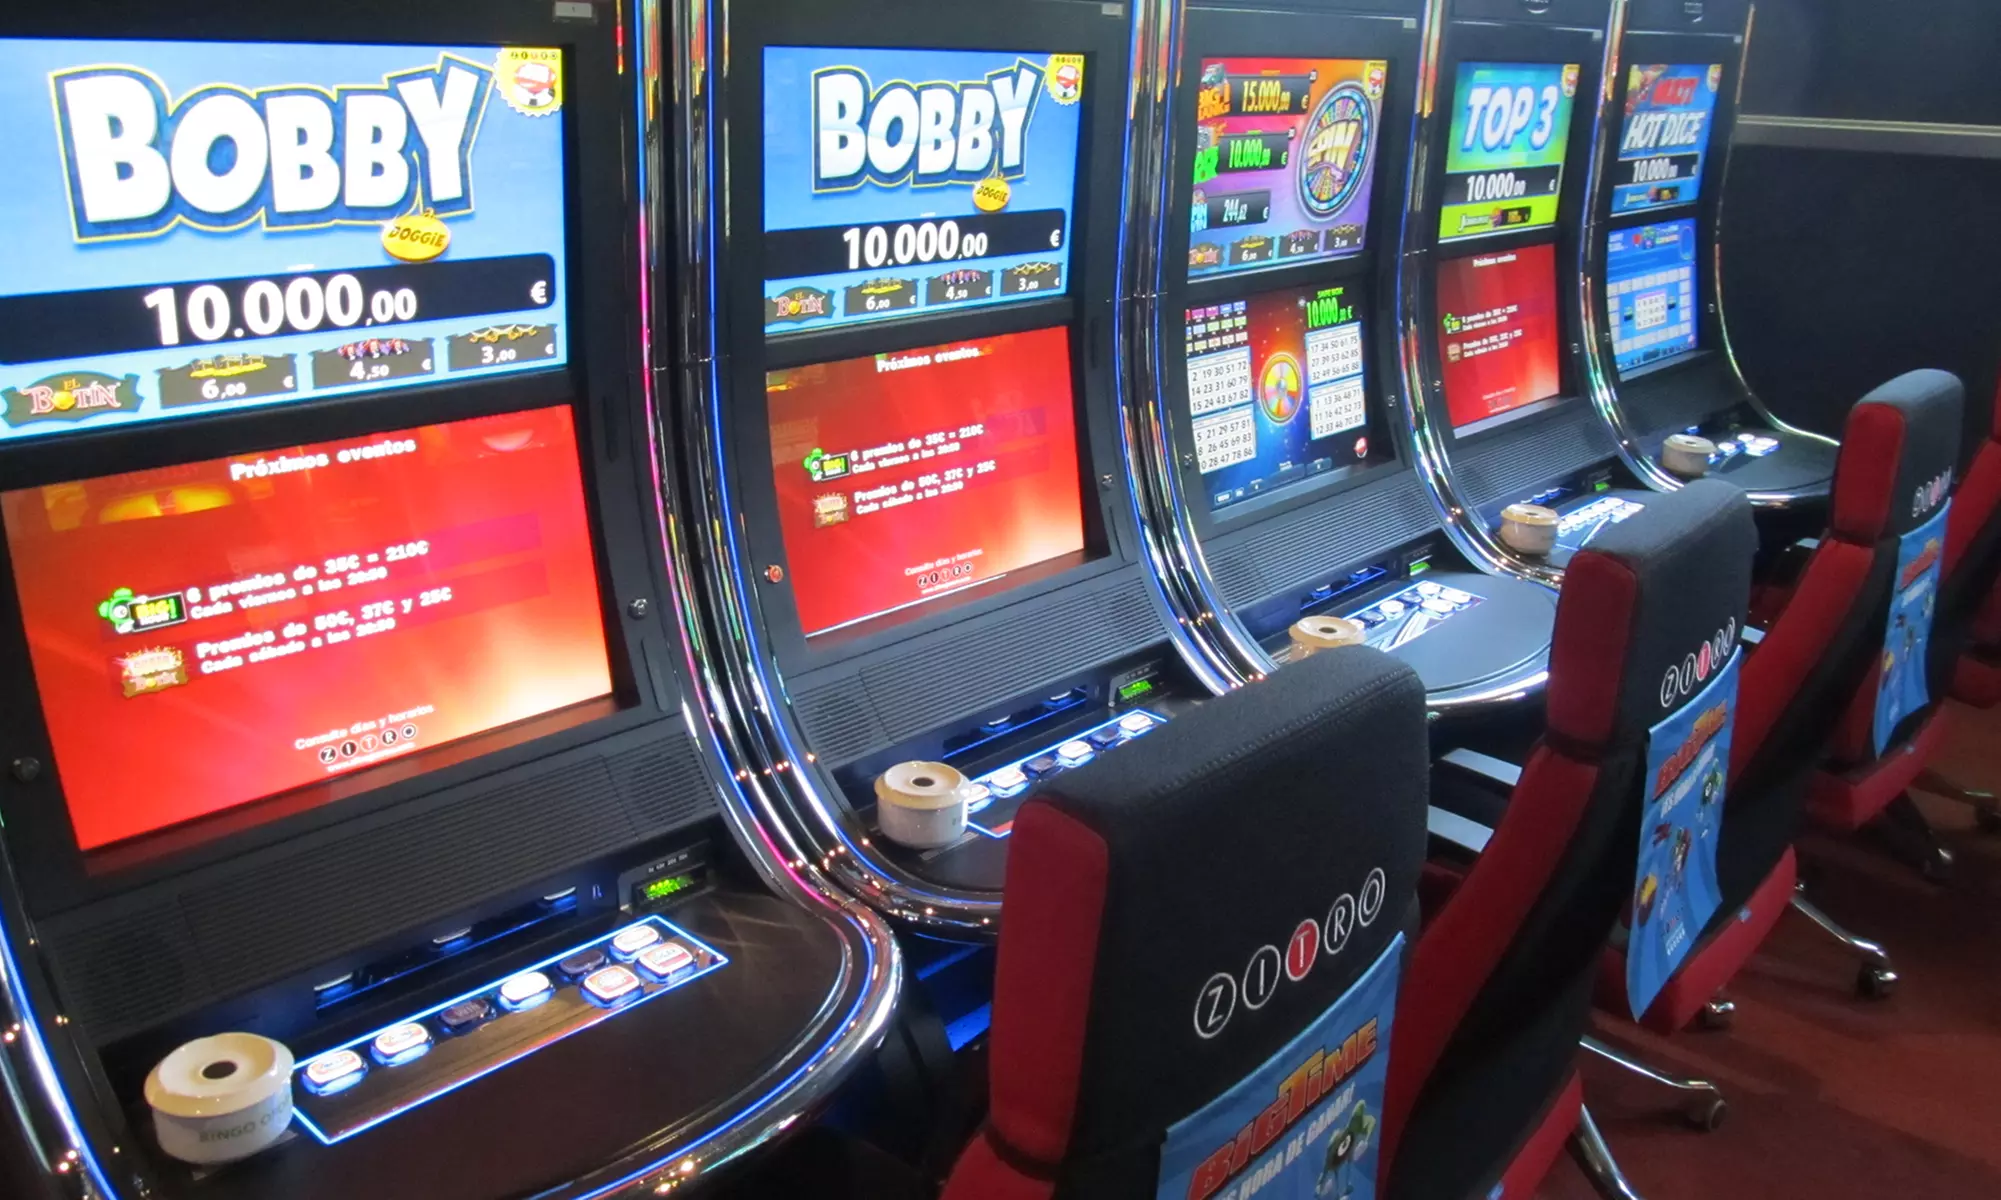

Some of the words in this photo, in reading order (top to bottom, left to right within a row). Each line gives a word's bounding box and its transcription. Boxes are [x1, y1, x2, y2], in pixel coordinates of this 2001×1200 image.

[818, 67, 1037, 179] BOBBY
[1463, 86, 1534, 150] TOP
[1529, 86, 1559, 150] 3
[1621, 113, 1667, 152] HOT
[1659, 111, 1706, 147] DICE
[62, 64, 482, 225] BOBBY
[843, 220, 988, 269] 10.000,00
[1050, 229, 1061, 247] €
[143, 273, 418, 346] 10.000,00
[530, 281, 549, 305] €
[350, 363, 390, 380] 4,50
[422, 358, 432, 371] €
[481, 346, 517, 364] 3,00
[545, 344, 555, 356] €
[1192, 372, 1198, 382] 2
[1203, 368, 1212, 379] 19
[1214, 367, 1224, 377] 30
[1225, 364, 1235, 374] 51
[1238, 361, 1247, 370] 72
[201, 378, 246, 400] 6,00
[283, 376, 294, 389] €
[1192, 387, 1201, 397] 14
[1203, 384, 1213, 394] 23
[1215, 381, 1225, 391] 31
[1226, 378, 1237, 388] 60
[1239, 375, 1248, 385] 79
[1192, 402, 1202, 412] 15
[1204, 398, 1214, 409] 24
[1216, 395, 1226, 405] 43
[1239, 389, 1249, 399] 82
[230, 452, 330, 481] Próximos
[336, 438, 417, 463] eventos
[208, 572, 286, 602] premios
[292, 565, 318, 581] de
[195, 630, 276, 659] Premios
[282, 621, 308, 638] de
[320, 723, 418, 764] ZITRO
[1192, 866, 1387, 1040] ZITRO
